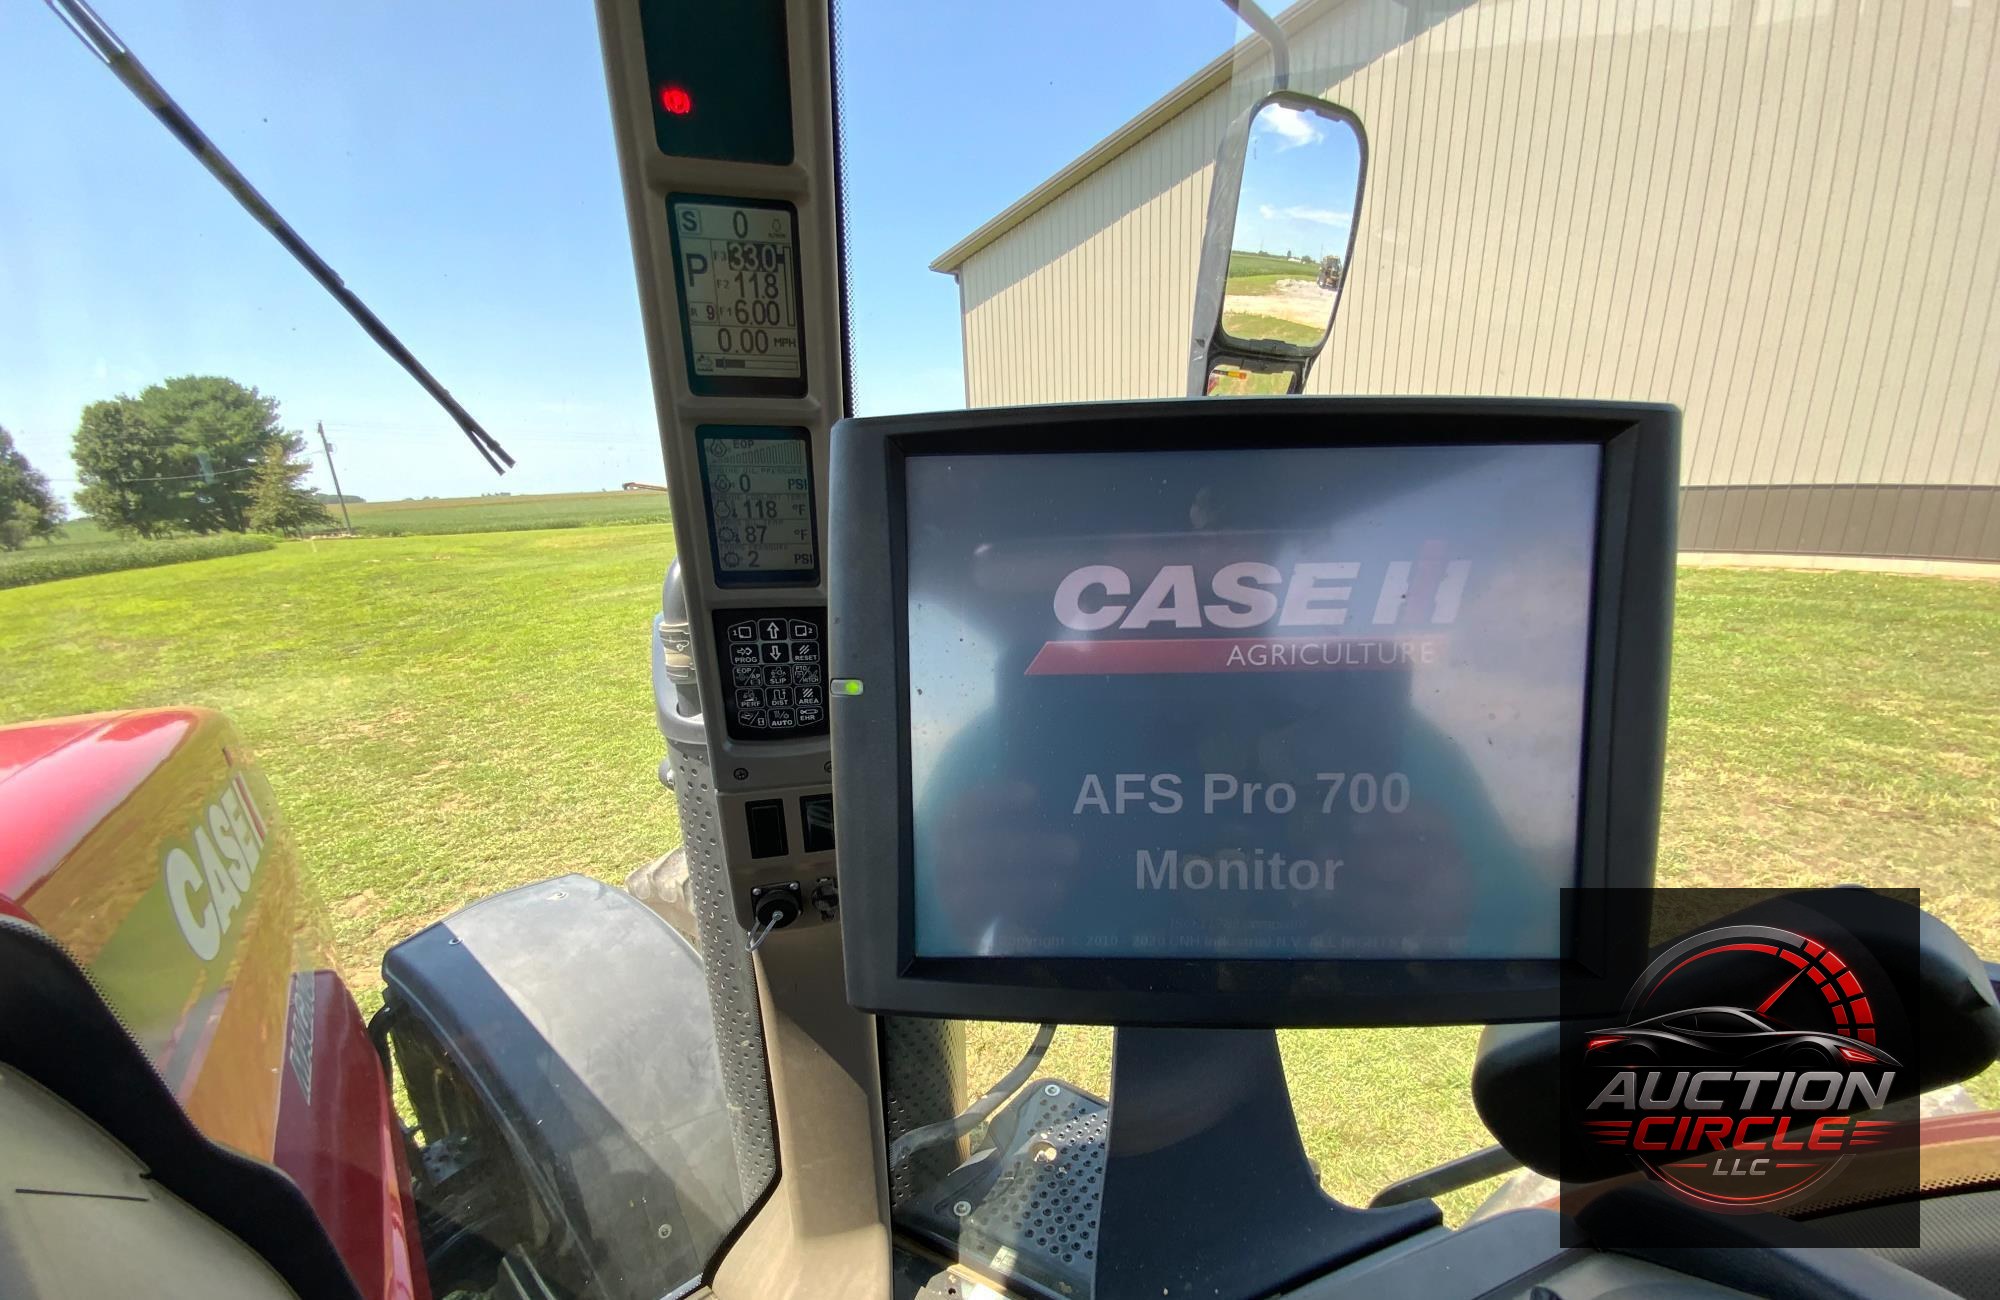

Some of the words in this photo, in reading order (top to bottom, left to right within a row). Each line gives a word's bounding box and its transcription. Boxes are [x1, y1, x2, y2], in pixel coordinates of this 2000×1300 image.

[681, 210, 698, 232] S
[733, 210, 748, 239] 0
[685, 252, 708, 288] P
[706, 304, 716, 321] 9
[735, 299, 781, 326] 6.00
[717, 327, 769, 354] 0.00
[773, 336, 797, 348] MPH
[732, 439, 754, 449] EOP
[739, 473, 751, 493] 0
[787, 478, 808, 491] PSI
[743, 499, 778, 519] 118
[745, 525, 768, 544] 87
[748, 550, 760, 568] 2
[794, 553, 813, 565] PSI
[1052, 561, 1361, 631] CASE
[1226, 641, 1434, 667] AGRICULTURE
[1072, 772, 1184, 815] AFS
[1204, 772, 1296, 815] Pro
[1317, 772, 1411, 815] 700
[165, 785, 262, 961] CASE
[1136, 848, 1344, 891] Monitor
